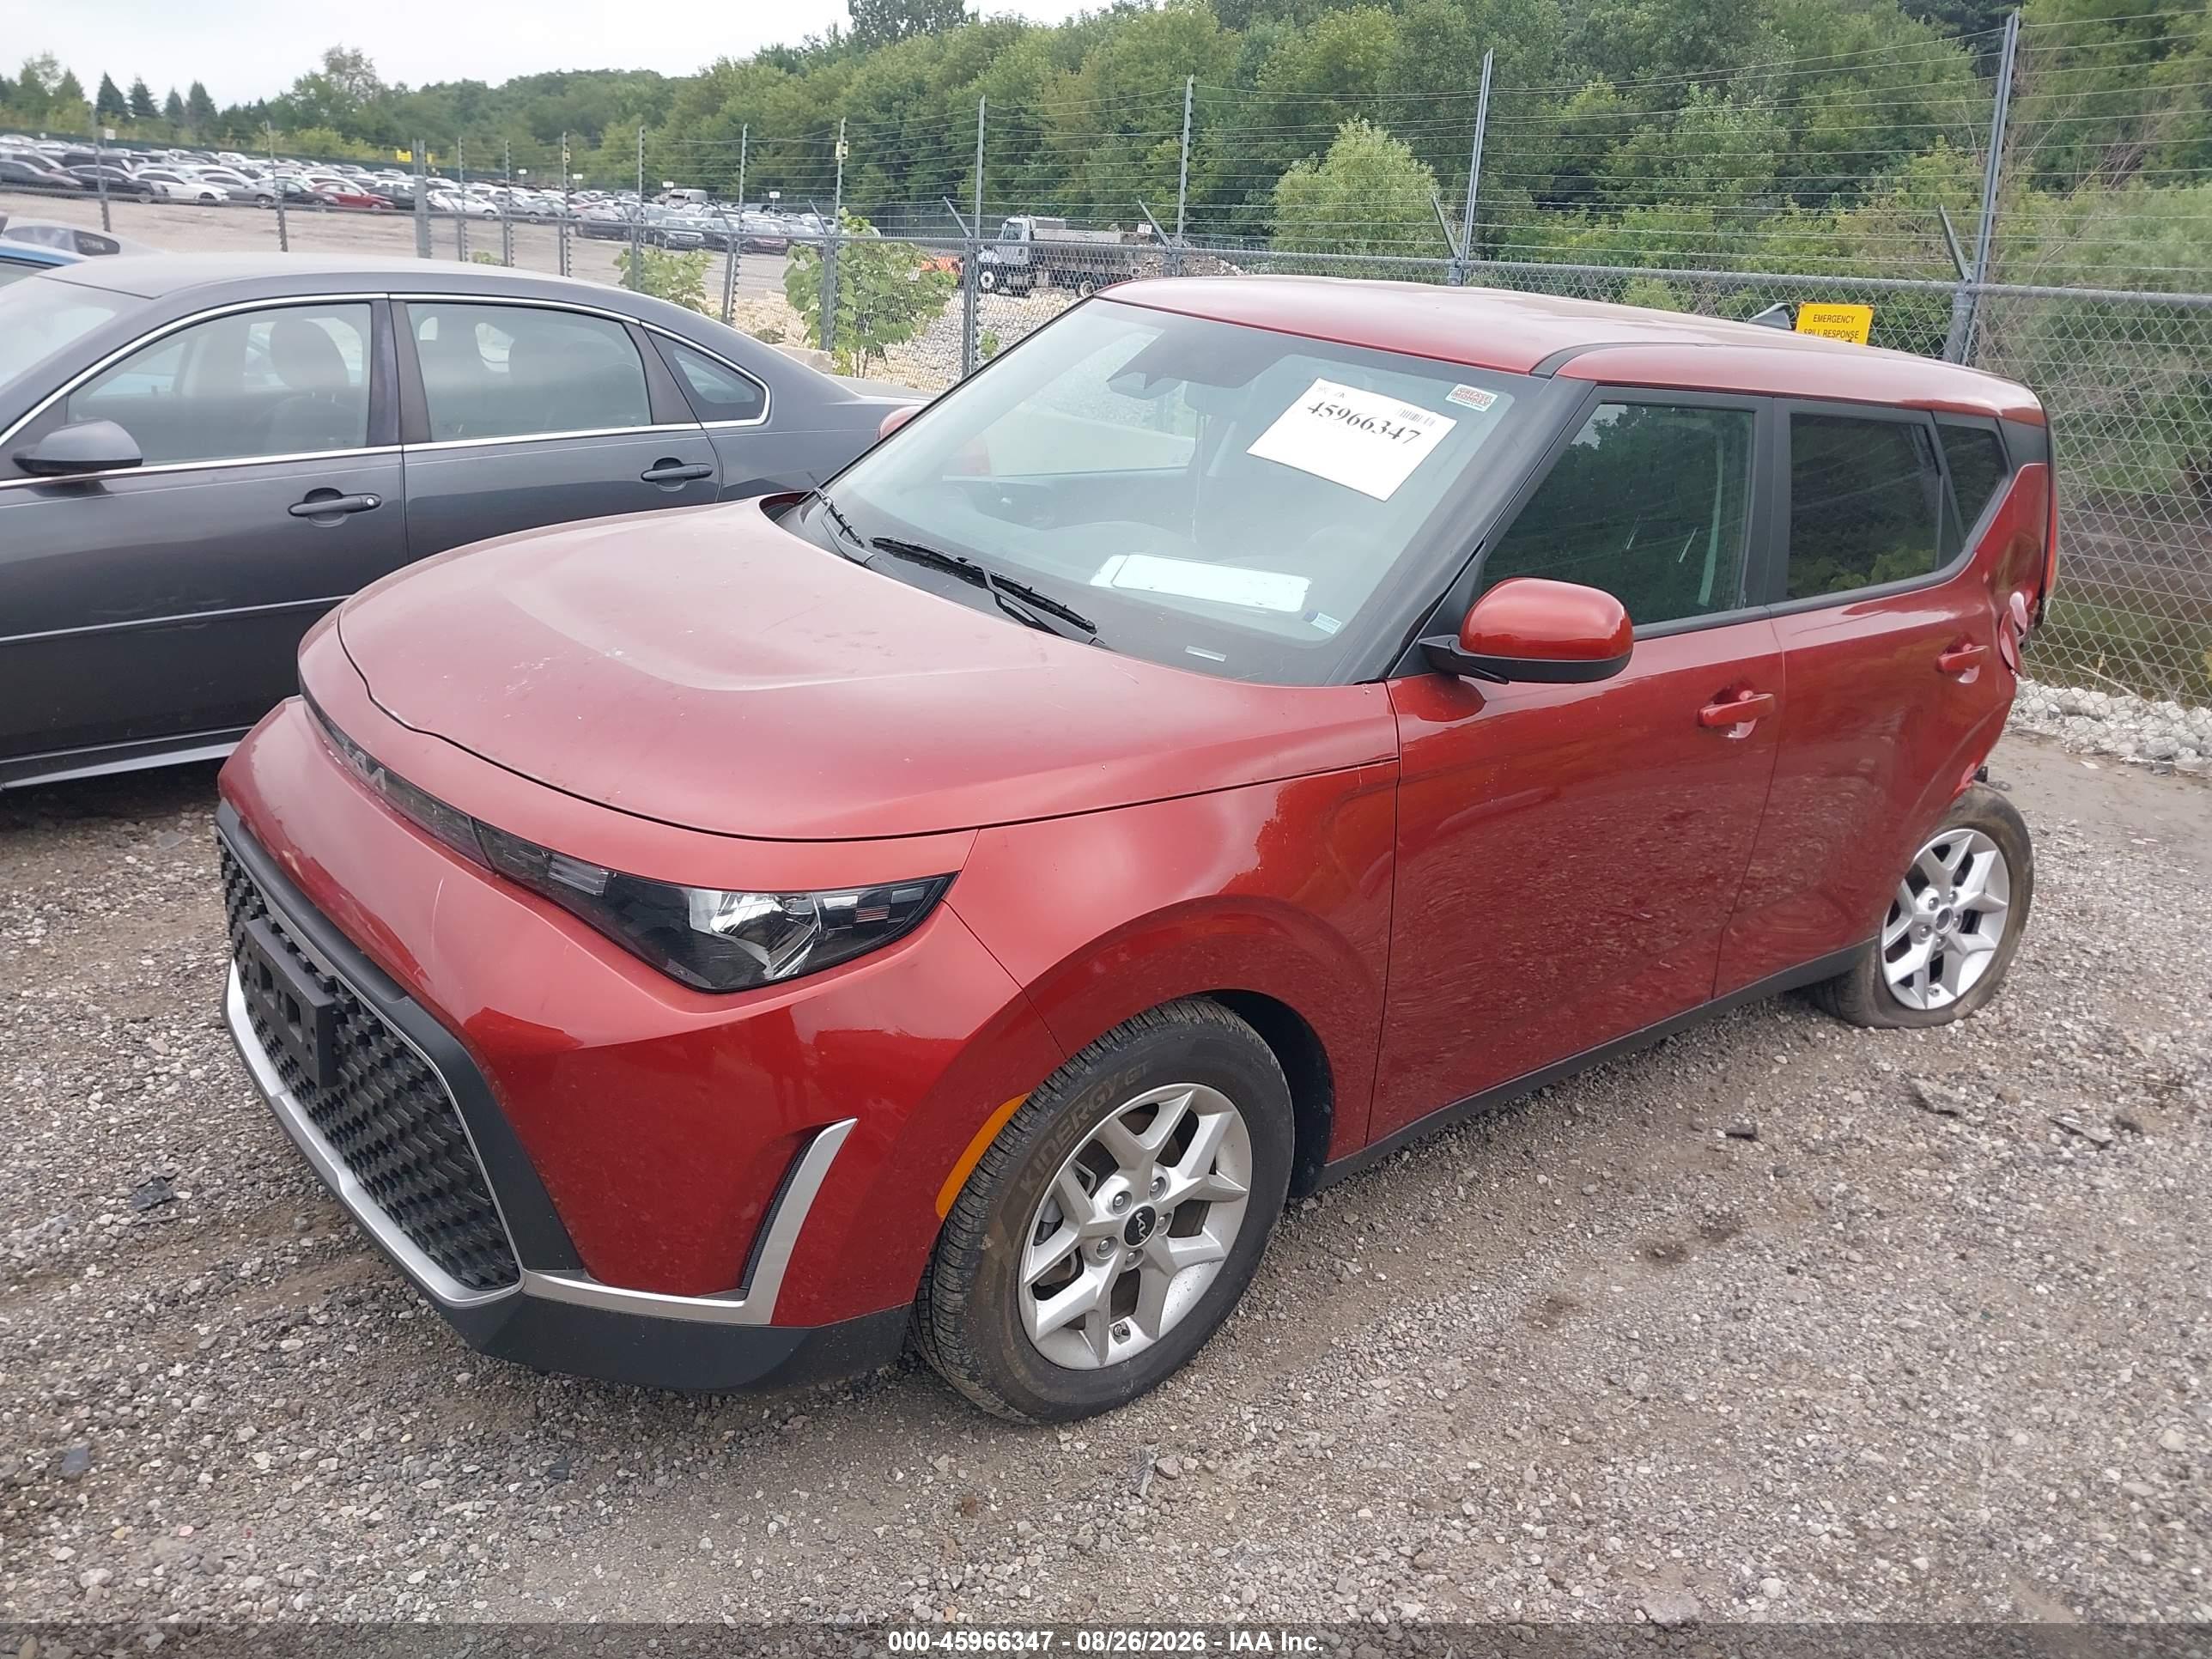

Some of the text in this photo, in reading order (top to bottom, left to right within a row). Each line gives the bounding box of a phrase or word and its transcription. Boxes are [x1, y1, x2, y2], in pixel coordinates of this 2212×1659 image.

[1813, 314, 1856, 324] EMERGENCY
[1822, 330, 1860, 339] RESPONSE
[1307, 401, 1422, 444] 45966347
[1019, 1072, 1120, 1190] KINERGY
